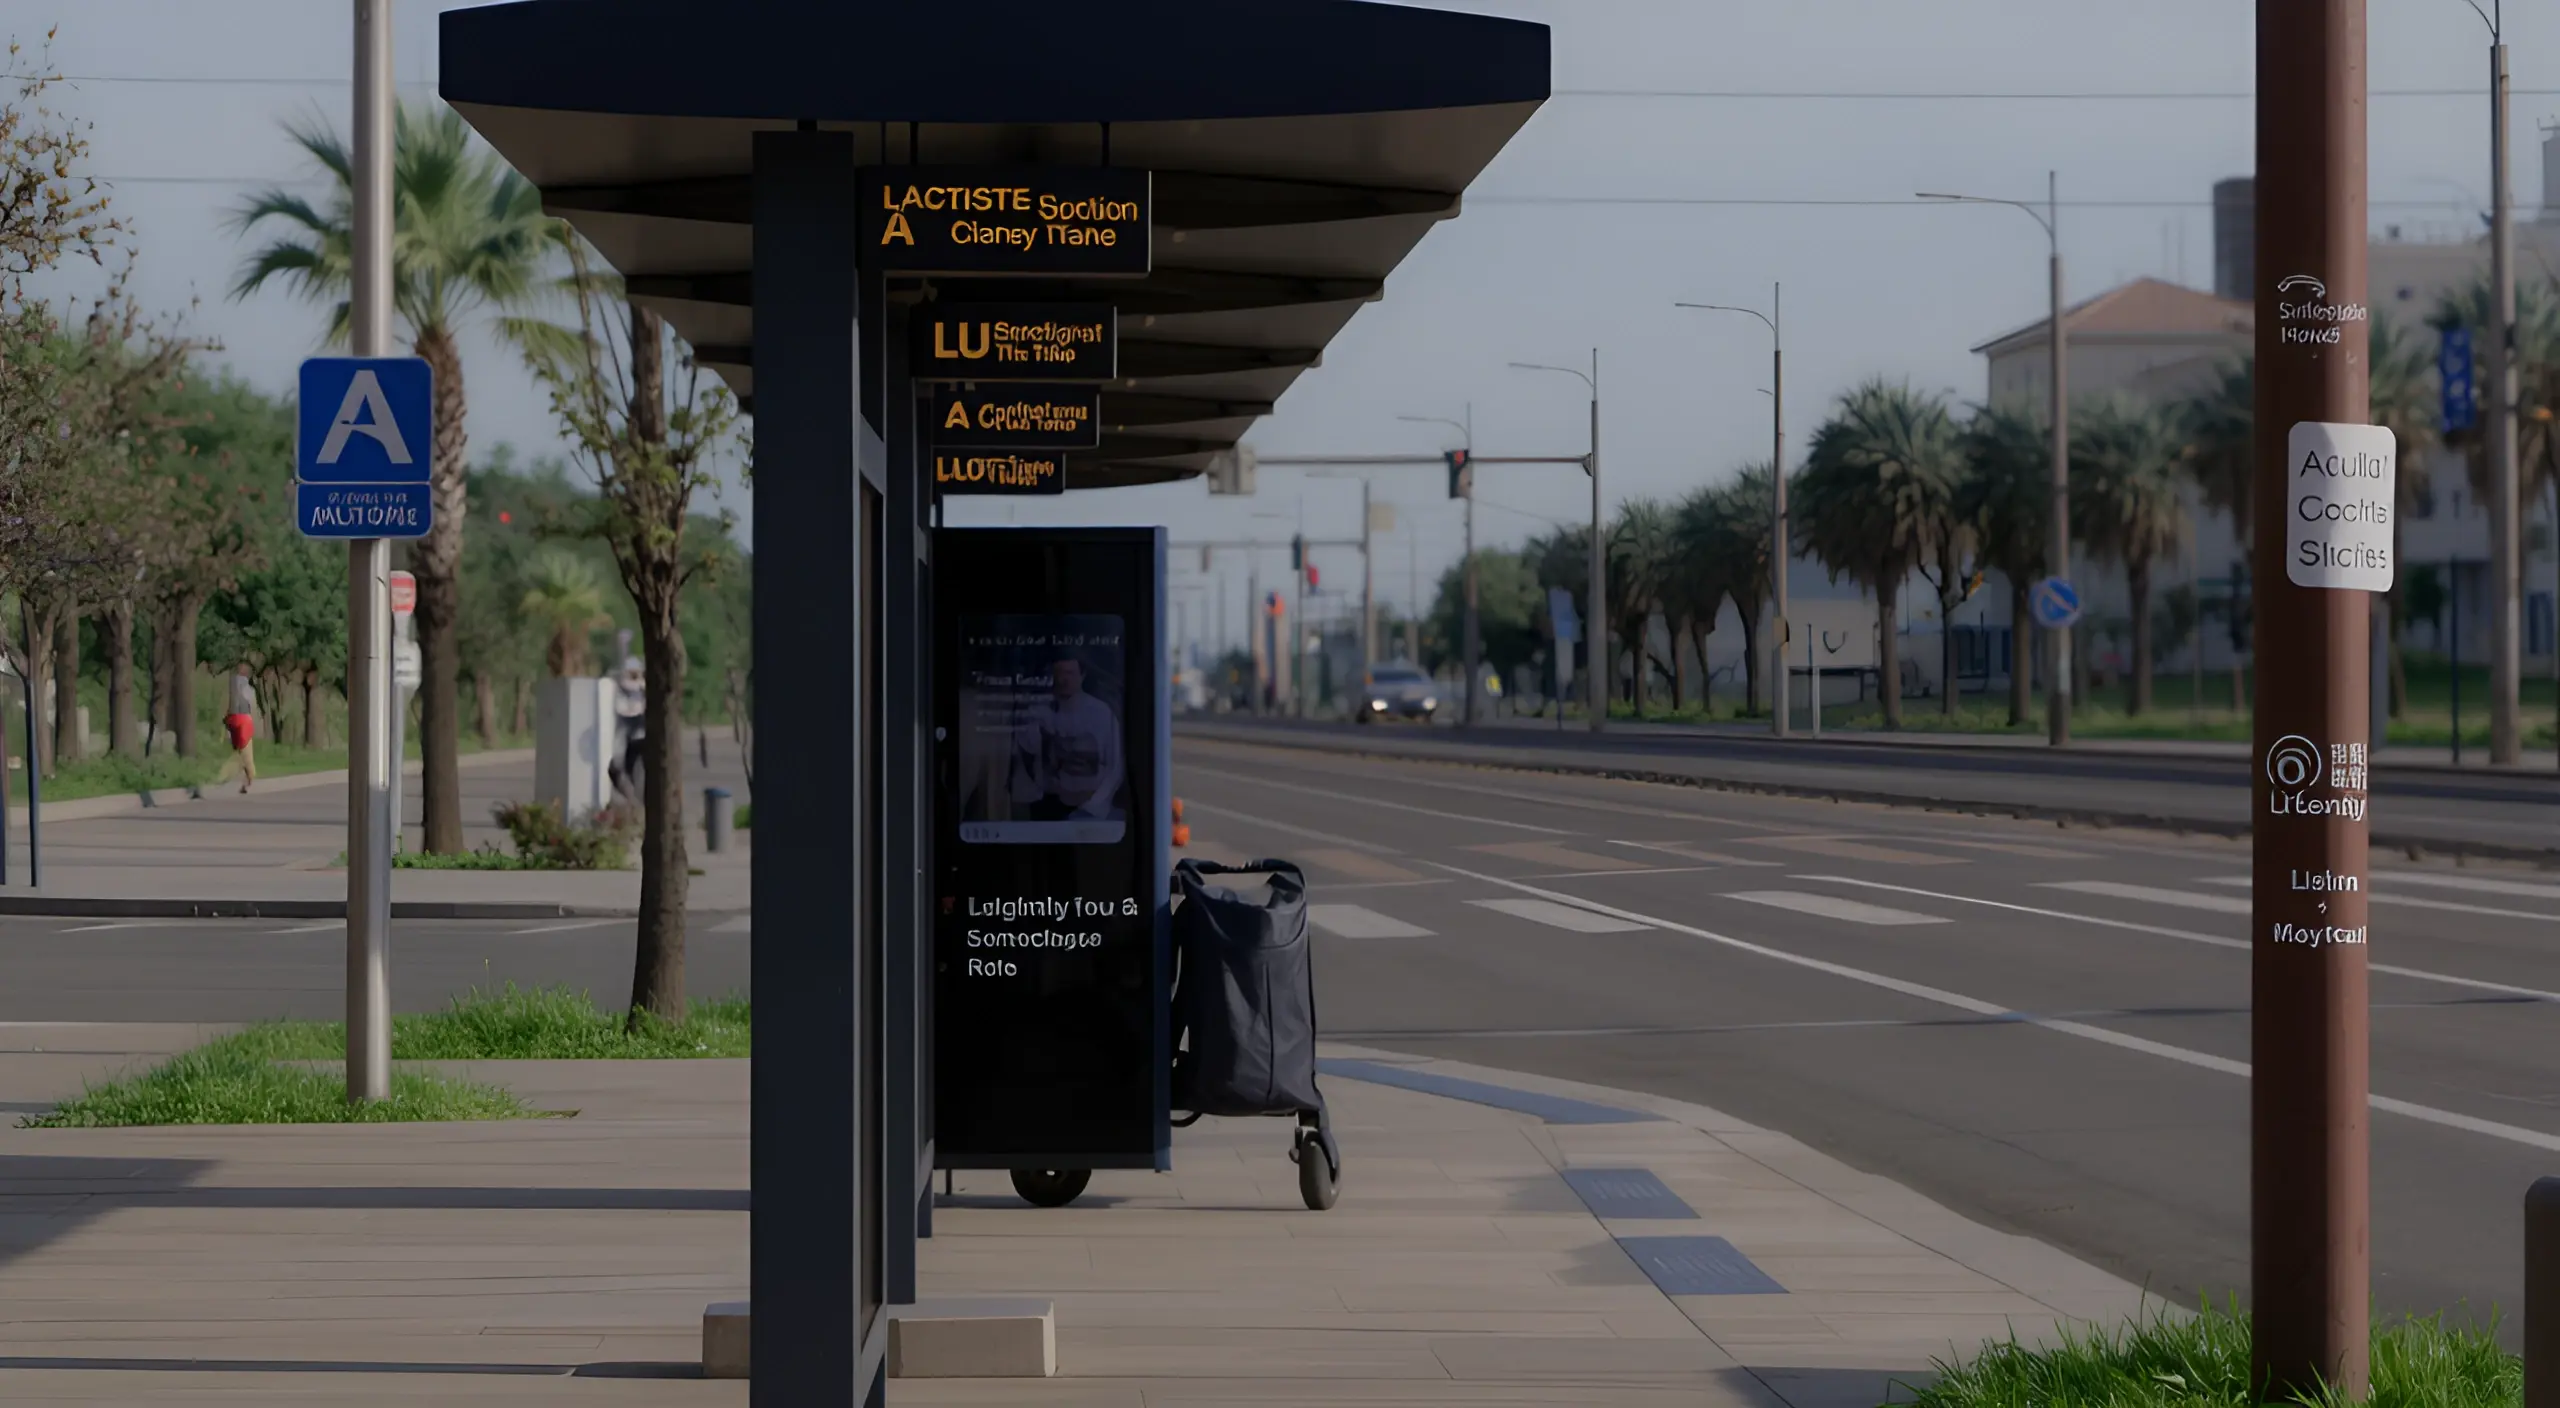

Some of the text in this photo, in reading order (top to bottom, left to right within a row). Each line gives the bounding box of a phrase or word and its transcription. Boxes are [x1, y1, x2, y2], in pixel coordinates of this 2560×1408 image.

[884, 185, 1032, 212] LACTISTE
[881, 211, 915, 246] A
[935, 322, 990, 359] LU
[316, 369, 413, 464] A
